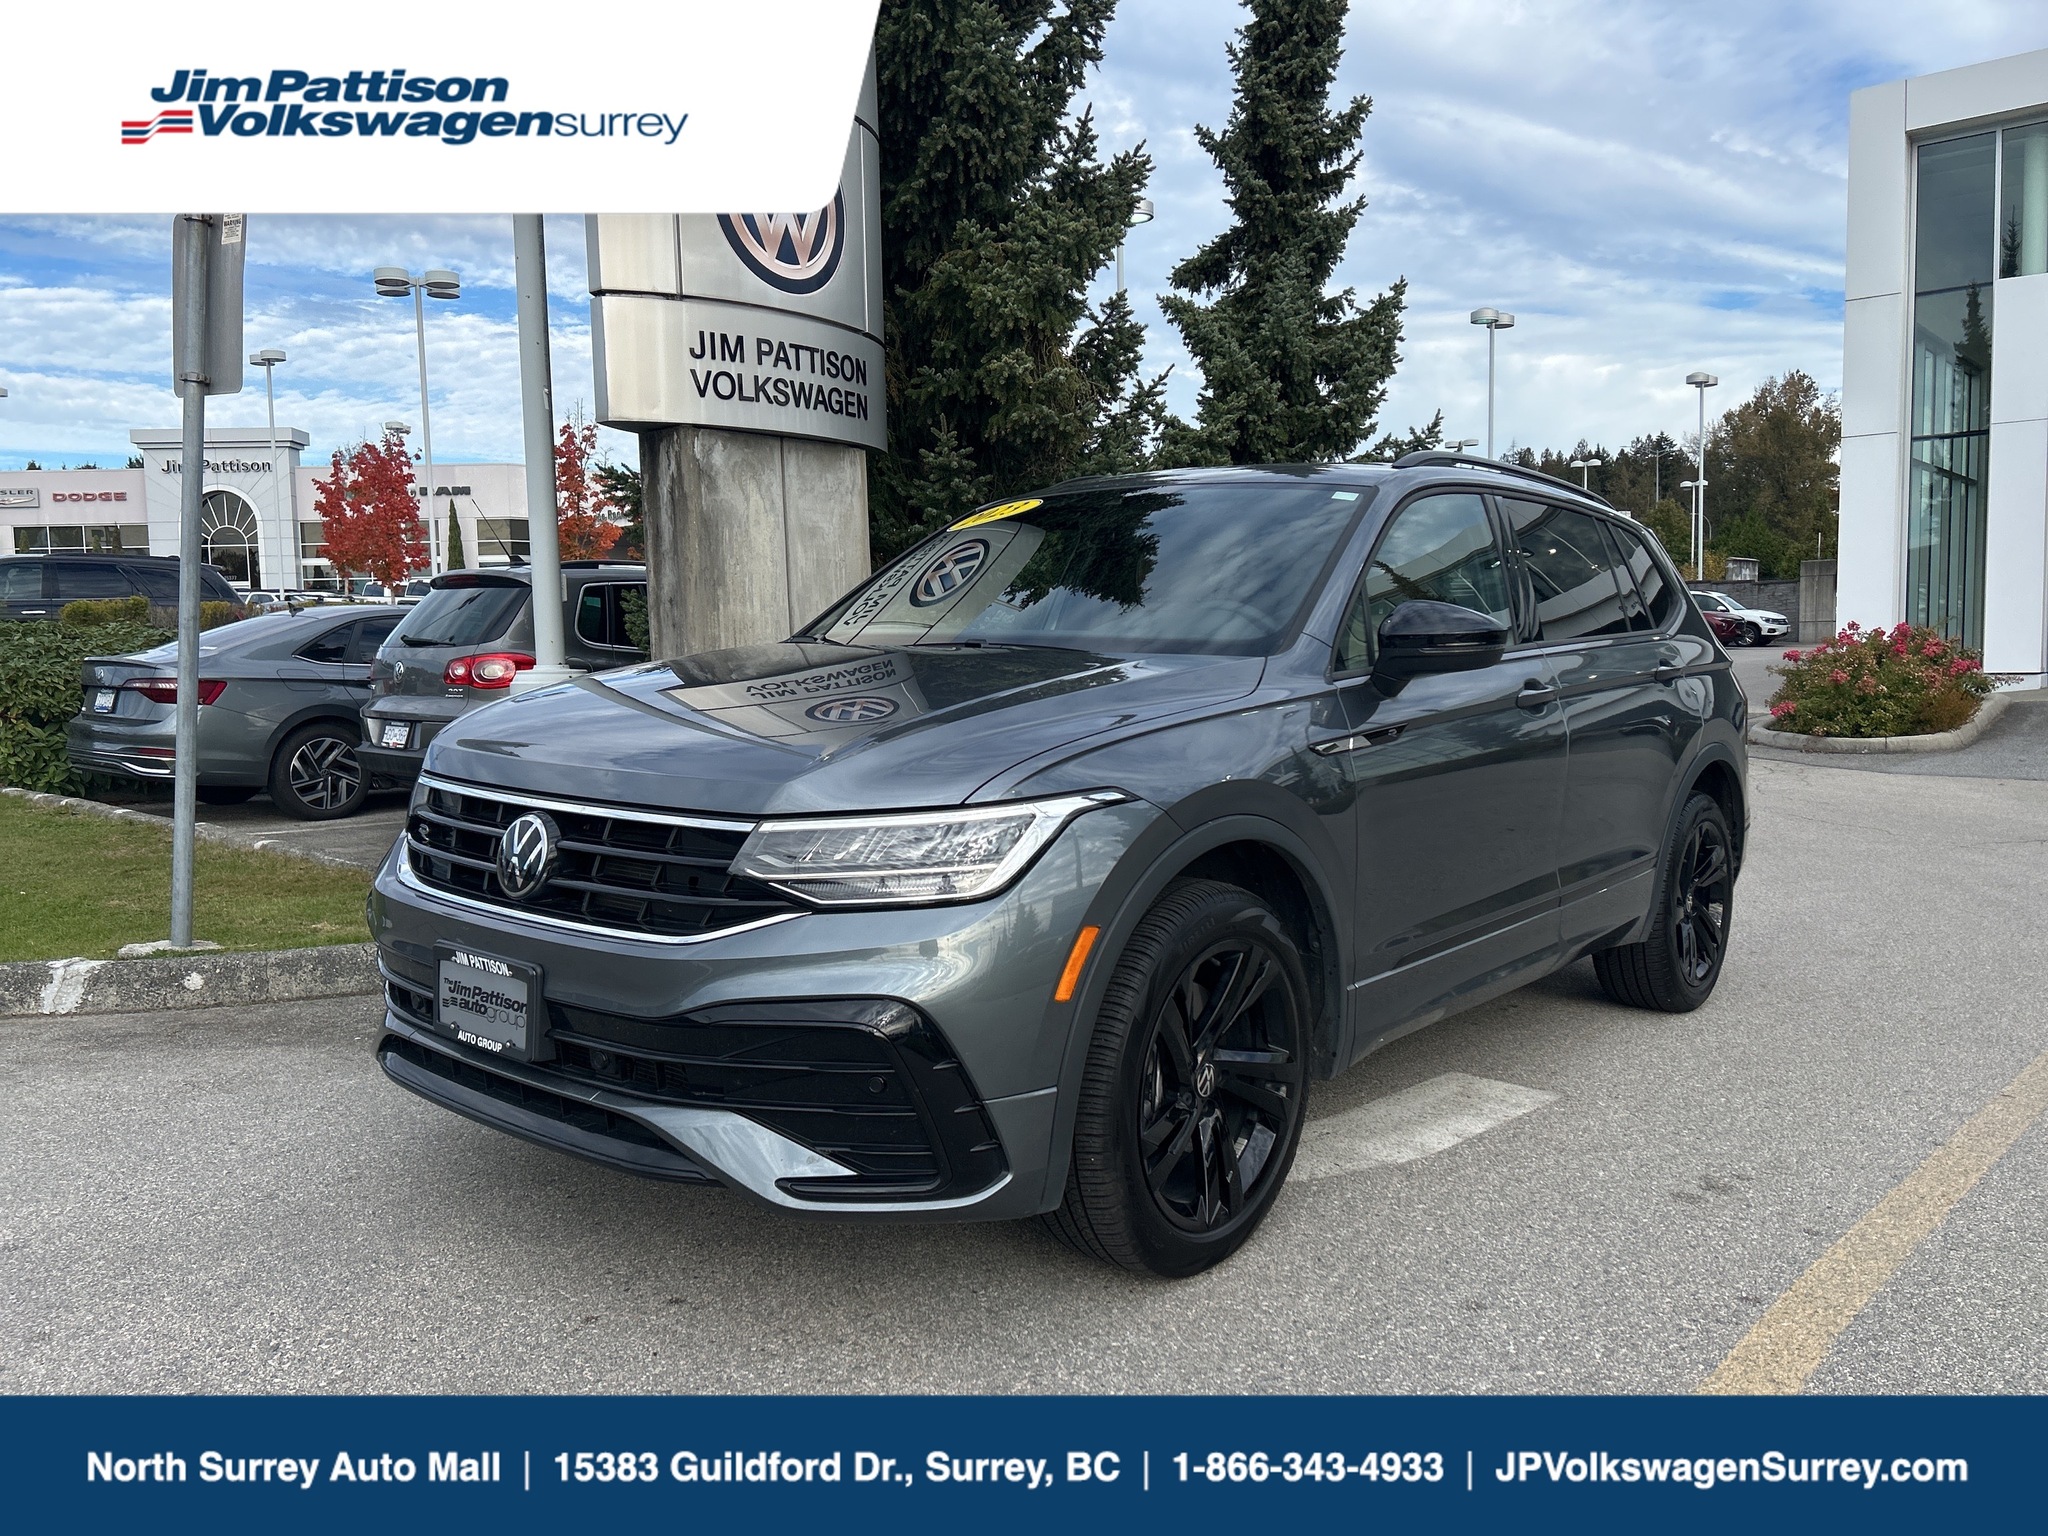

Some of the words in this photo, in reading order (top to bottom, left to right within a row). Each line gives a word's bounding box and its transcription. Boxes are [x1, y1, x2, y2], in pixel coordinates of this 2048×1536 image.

[689, 330, 745, 363] JIM
[756, 337, 868, 386] PATTISON
[690, 368, 869, 421] VOLKSWAGEN
[52, 492, 127, 502] DODGE
[455, 951, 470, 967] JIM
[469, 954, 509, 977] PATTISON
[448, 980, 472, 998] Jim
[472, 986, 528, 1015] Pattison
[457, 1030, 476, 1045] AUTO
[477, 1037, 503, 1053] GROUP
